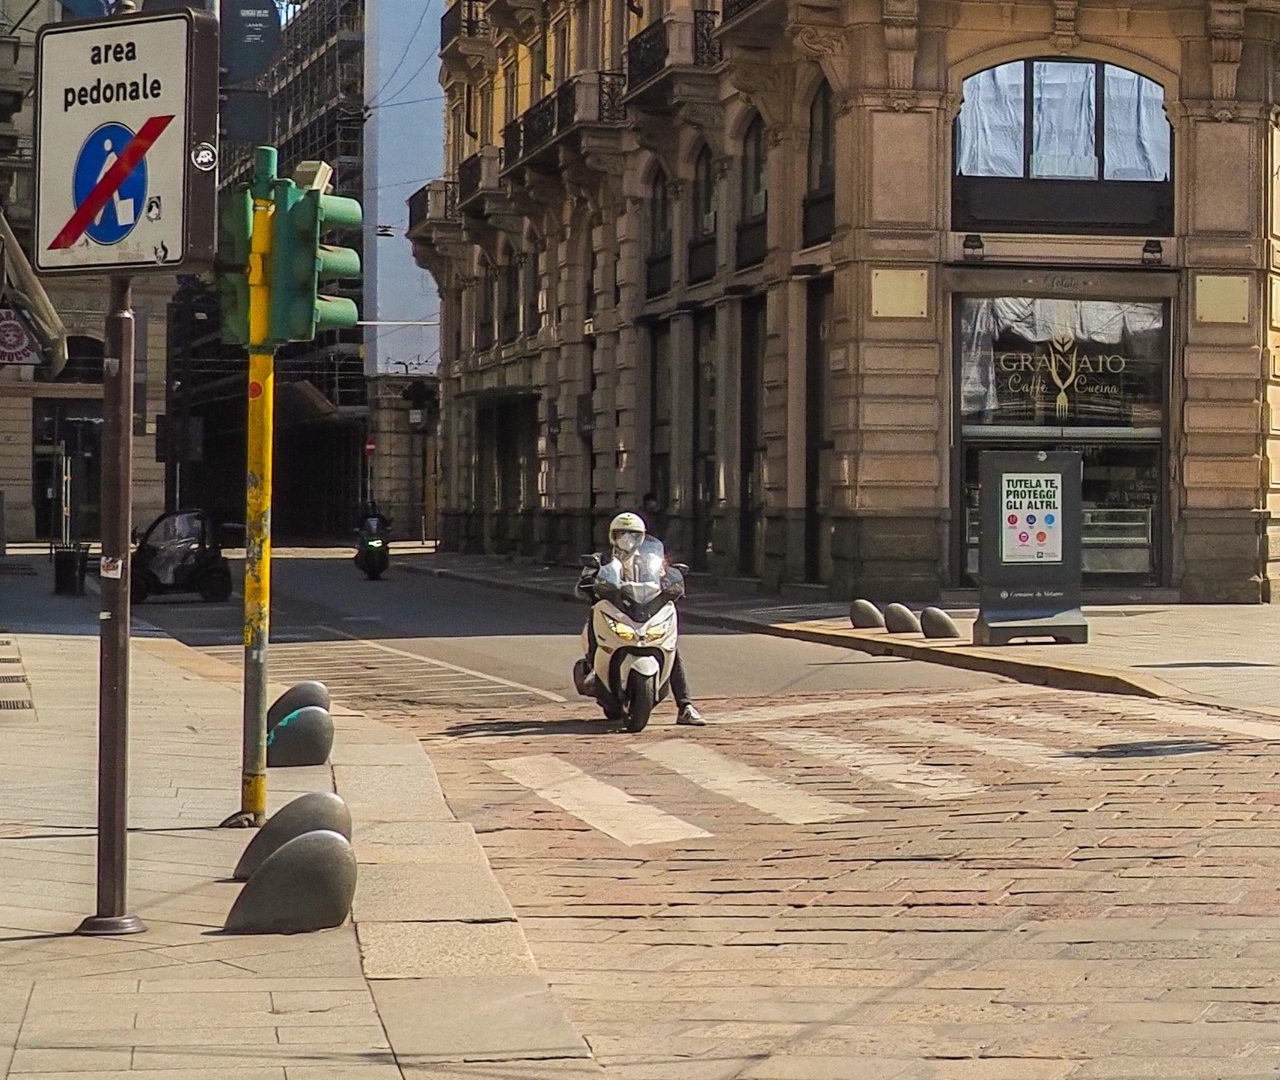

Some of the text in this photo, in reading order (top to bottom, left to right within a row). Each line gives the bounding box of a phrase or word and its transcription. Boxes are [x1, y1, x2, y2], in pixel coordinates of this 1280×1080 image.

[91, 41, 137, 65] area
[63, 72, 162, 112] pedonale
[999, 352, 1126, 374] GRANAIO
[1008, 373, 1120, 395] Caffè Cucina
[1006, 479, 1059, 491] TUTELA TE,
[1006, 489, 1056, 500] PROTEGGI
[1006, 500, 1023, 510] GLI
